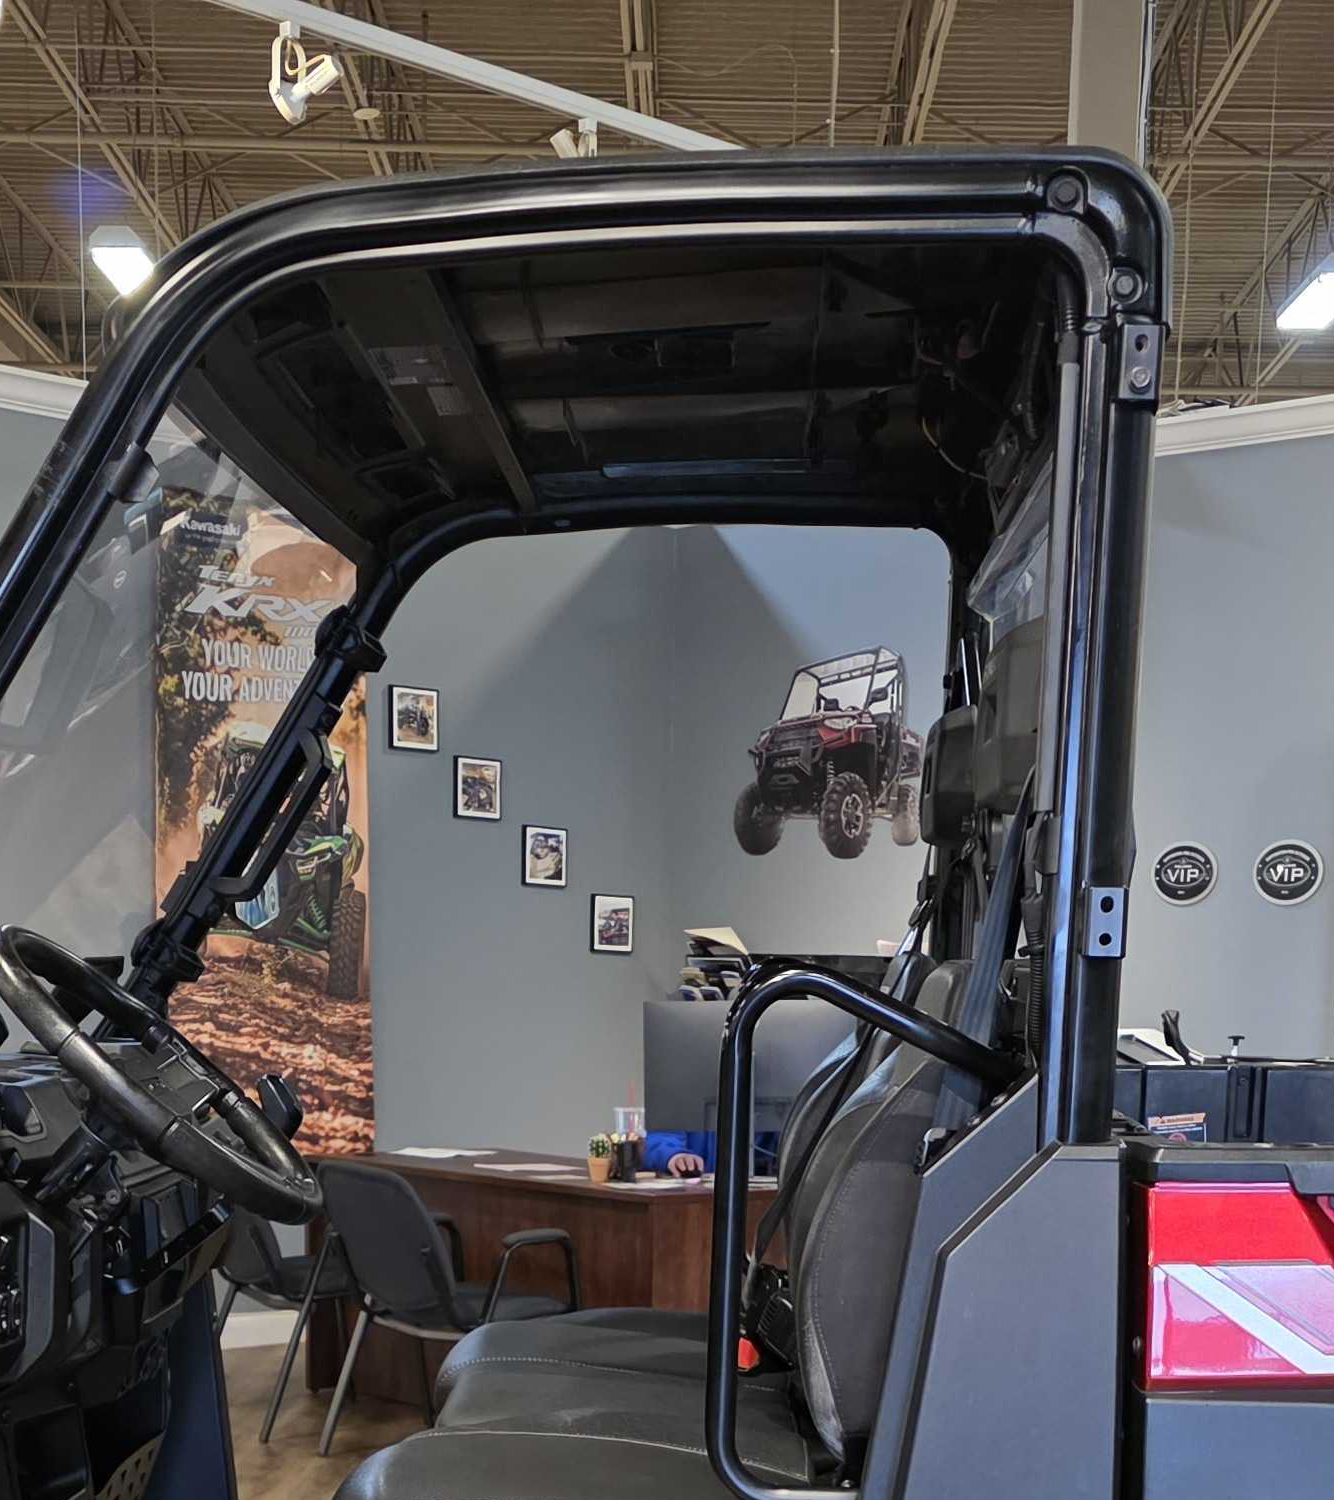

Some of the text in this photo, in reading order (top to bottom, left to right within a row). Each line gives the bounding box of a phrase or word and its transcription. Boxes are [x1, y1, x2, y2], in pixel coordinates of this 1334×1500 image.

[180, 519, 241, 537] Kawasaki
[184, 582, 334, 623] KRX
[201, 638, 251, 669] YOUR
[181, 670, 233, 702] YOUR
[1167, 868, 1199, 883] VIP
[1270, 867, 1304, 882] VIP
